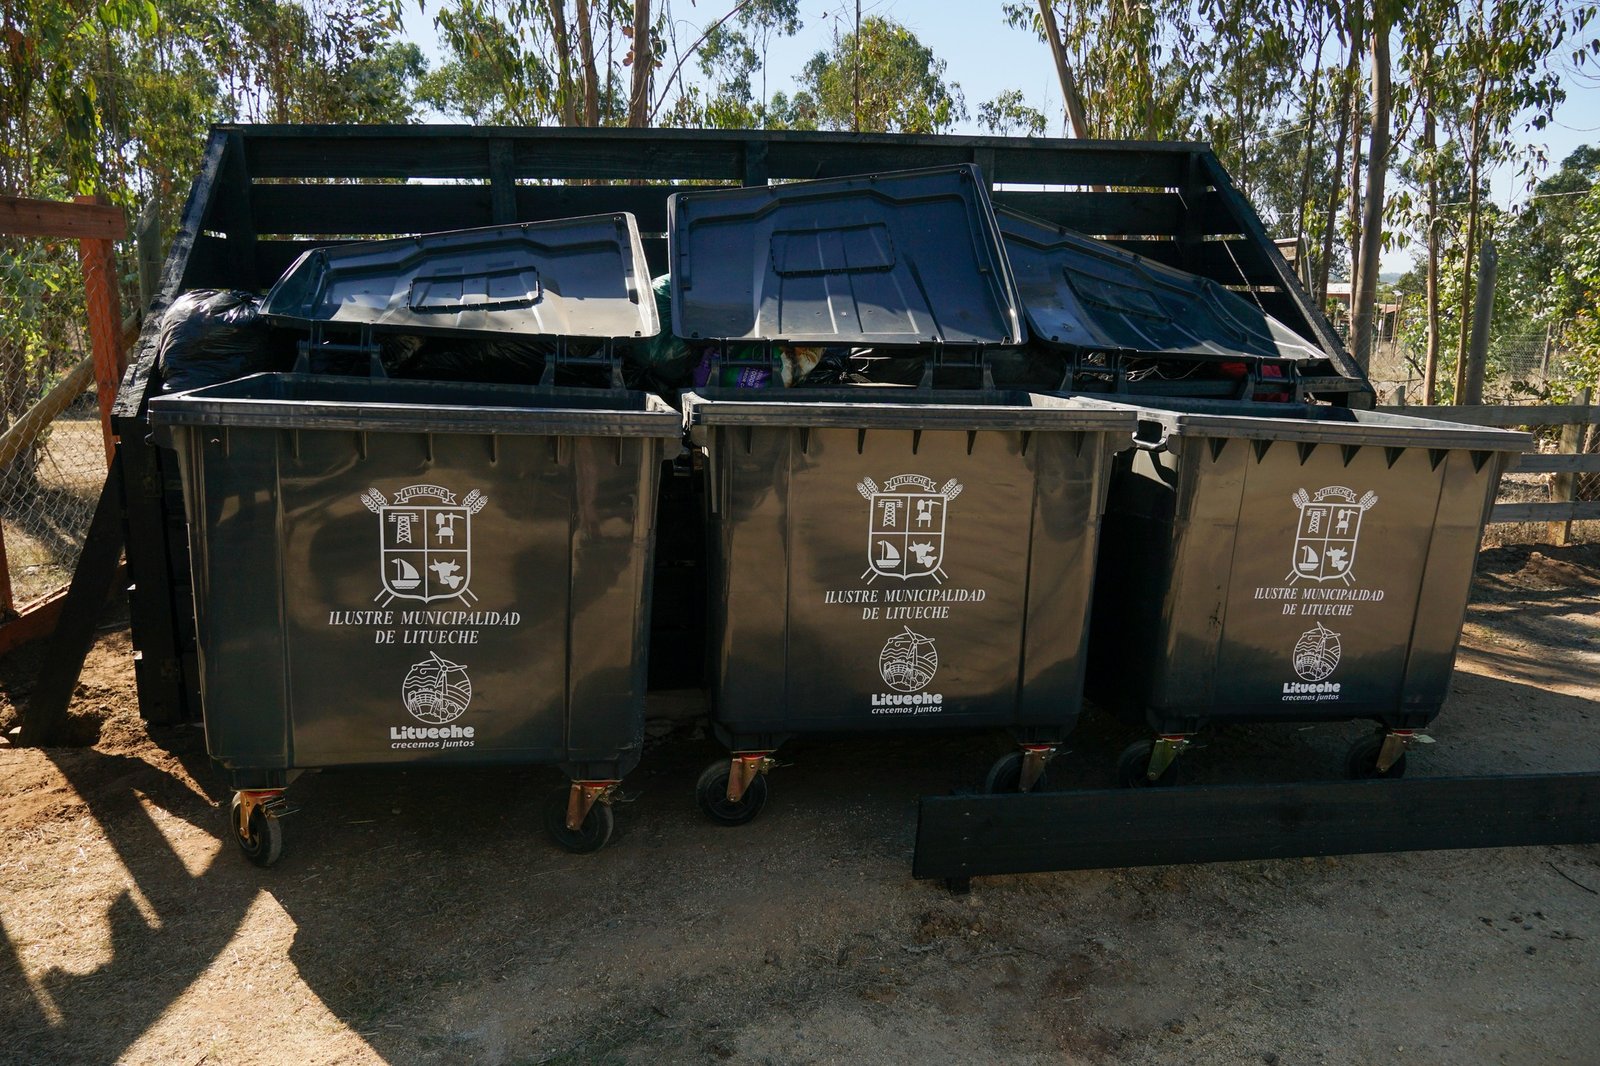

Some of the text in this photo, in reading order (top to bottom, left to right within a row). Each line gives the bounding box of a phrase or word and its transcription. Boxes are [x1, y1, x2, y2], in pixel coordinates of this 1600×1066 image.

[893, 476, 928, 486] LITUECHE
[404, 486, 445, 497] LITUECHE
[1321, 487, 1350, 497] LITUECHE
[825, 589, 986, 604] ILUSTRE MUNICIPALIDAD
[1254, 587, 1384, 601] ILUSTRE MUNICIPALIDAD
[862, 606, 950, 620] DE LITUECHE
[1282, 604, 1354, 616] DE LITUECHE
[328, 611, 521, 626] ILUSTRE MUNICIPALIDAD
[375, 630, 479, 644] DE LITUECHE
[1282, 681, 1341, 694] Litueche
[872, 692, 943, 706] Litueche
[1316, 694, 1339, 702] juntos
[872, 705, 942, 714] crecemos juntos
[390, 725, 474, 740] Litueche
[391, 740, 474, 749] crecemos juntos
